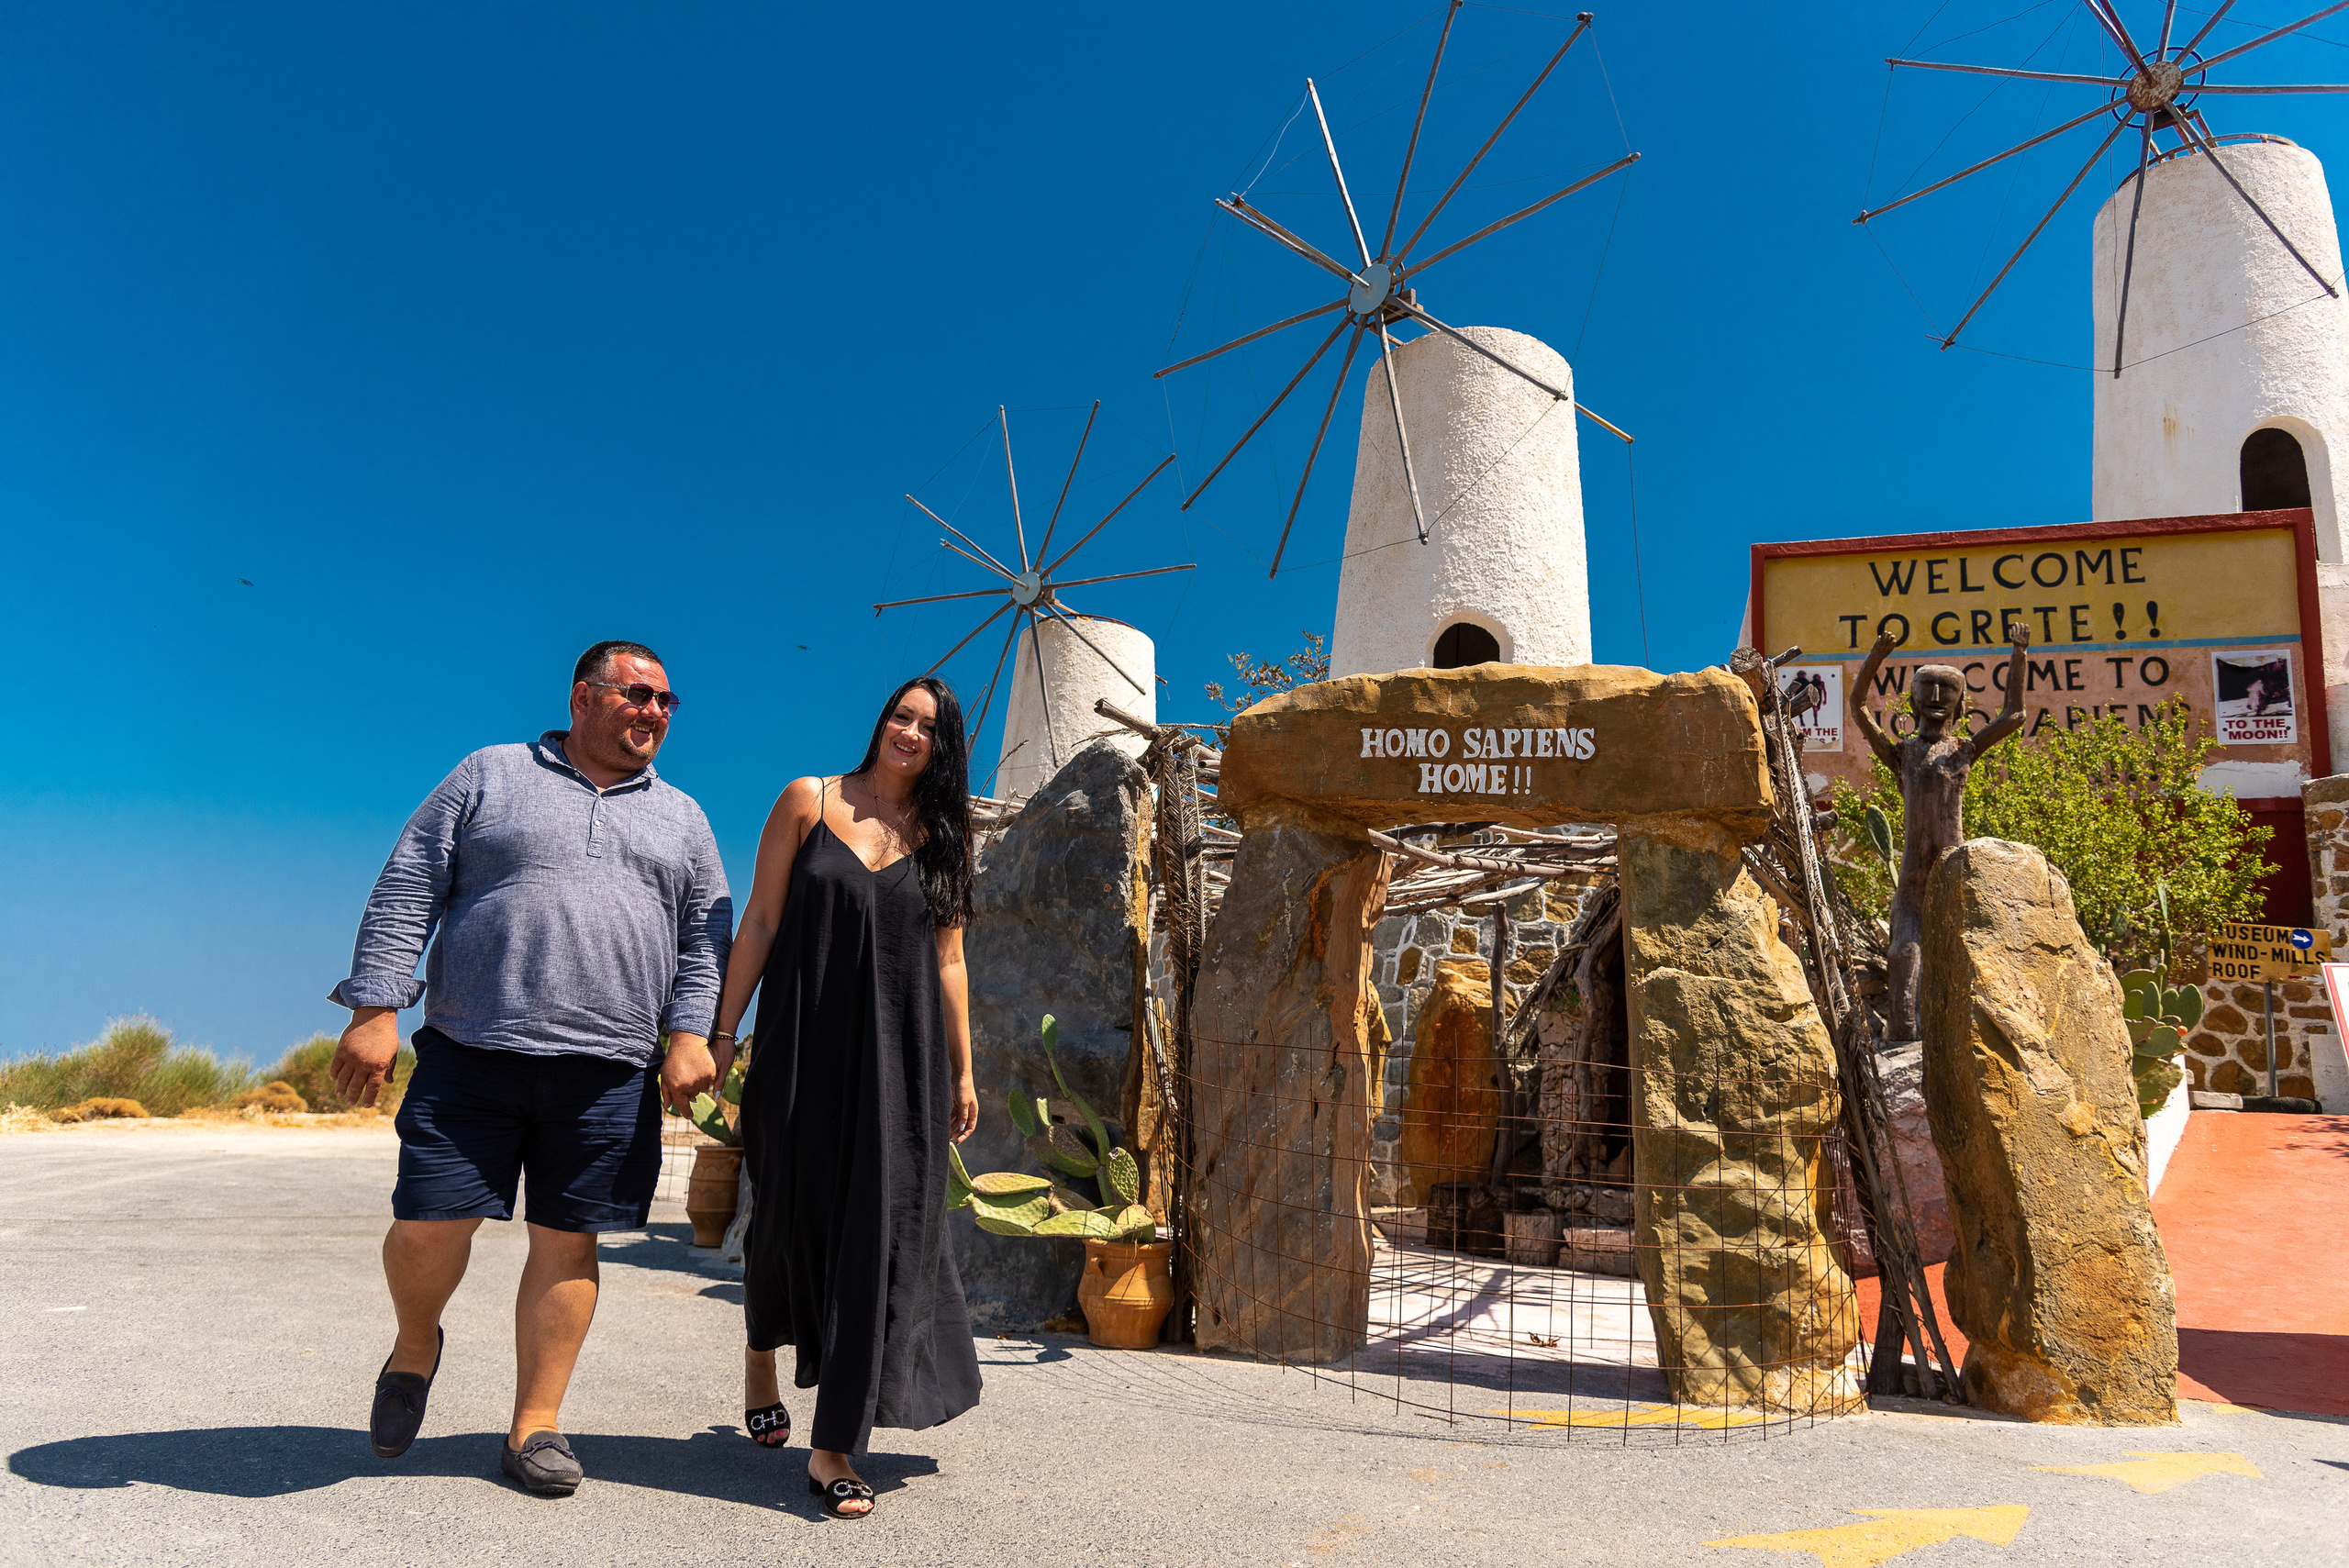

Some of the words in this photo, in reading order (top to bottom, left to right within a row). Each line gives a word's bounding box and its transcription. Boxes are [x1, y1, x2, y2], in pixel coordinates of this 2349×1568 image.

[1867, 547, 2146, 596] WELCOME
[1839, 612, 1910, 649] TO
[1873, 655, 2085, 696] WCOME
[2105, 655, 2170, 689] TO
[1815, 728, 1838, 737] THE
[2225, 719, 2247, 729] TO
[2252, 718, 2286, 728] THE
[2228, 729, 2288, 740] MOON!!
[1360, 728, 1451, 759] HOMO
[1463, 727, 1596, 761] SAPIENS
